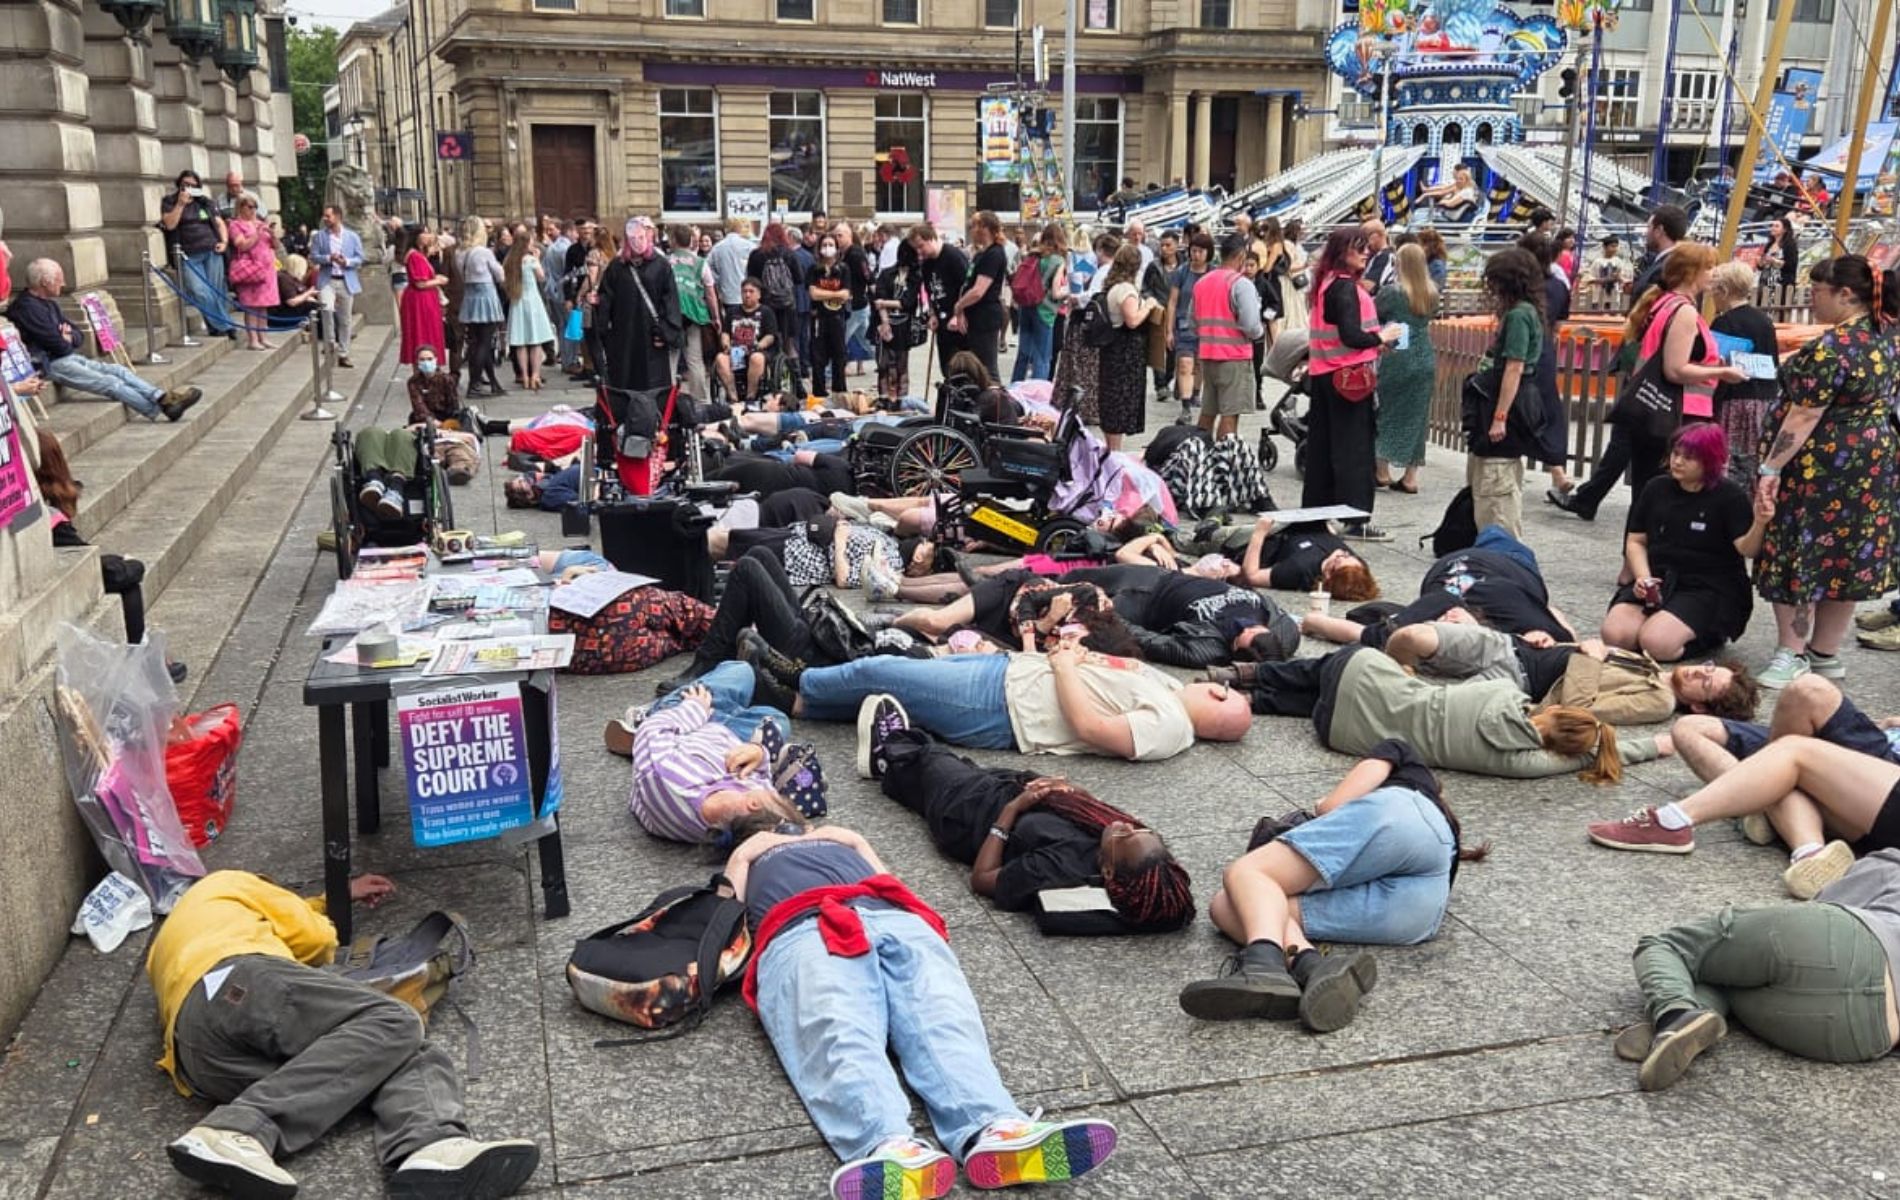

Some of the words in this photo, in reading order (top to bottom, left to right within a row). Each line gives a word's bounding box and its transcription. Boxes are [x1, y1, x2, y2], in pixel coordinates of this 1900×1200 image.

[881, 71, 936, 87] NatWest
[408, 711, 431, 723] Fight
[410, 718, 464, 748] DEFY
[470, 713, 513, 740] THE
[413, 738, 517, 772] SUPREME
[417, 765, 489, 798] COURT
[420, 804, 445, 816] Trans
[446, 800, 475, 811] women
[476, 798, 490, 808] are
[491, 793, 520, 805] women
[422, 816, 446, 828] Trans
[467, 812, 481, 821] are
[470, 821, 498, 836] people
